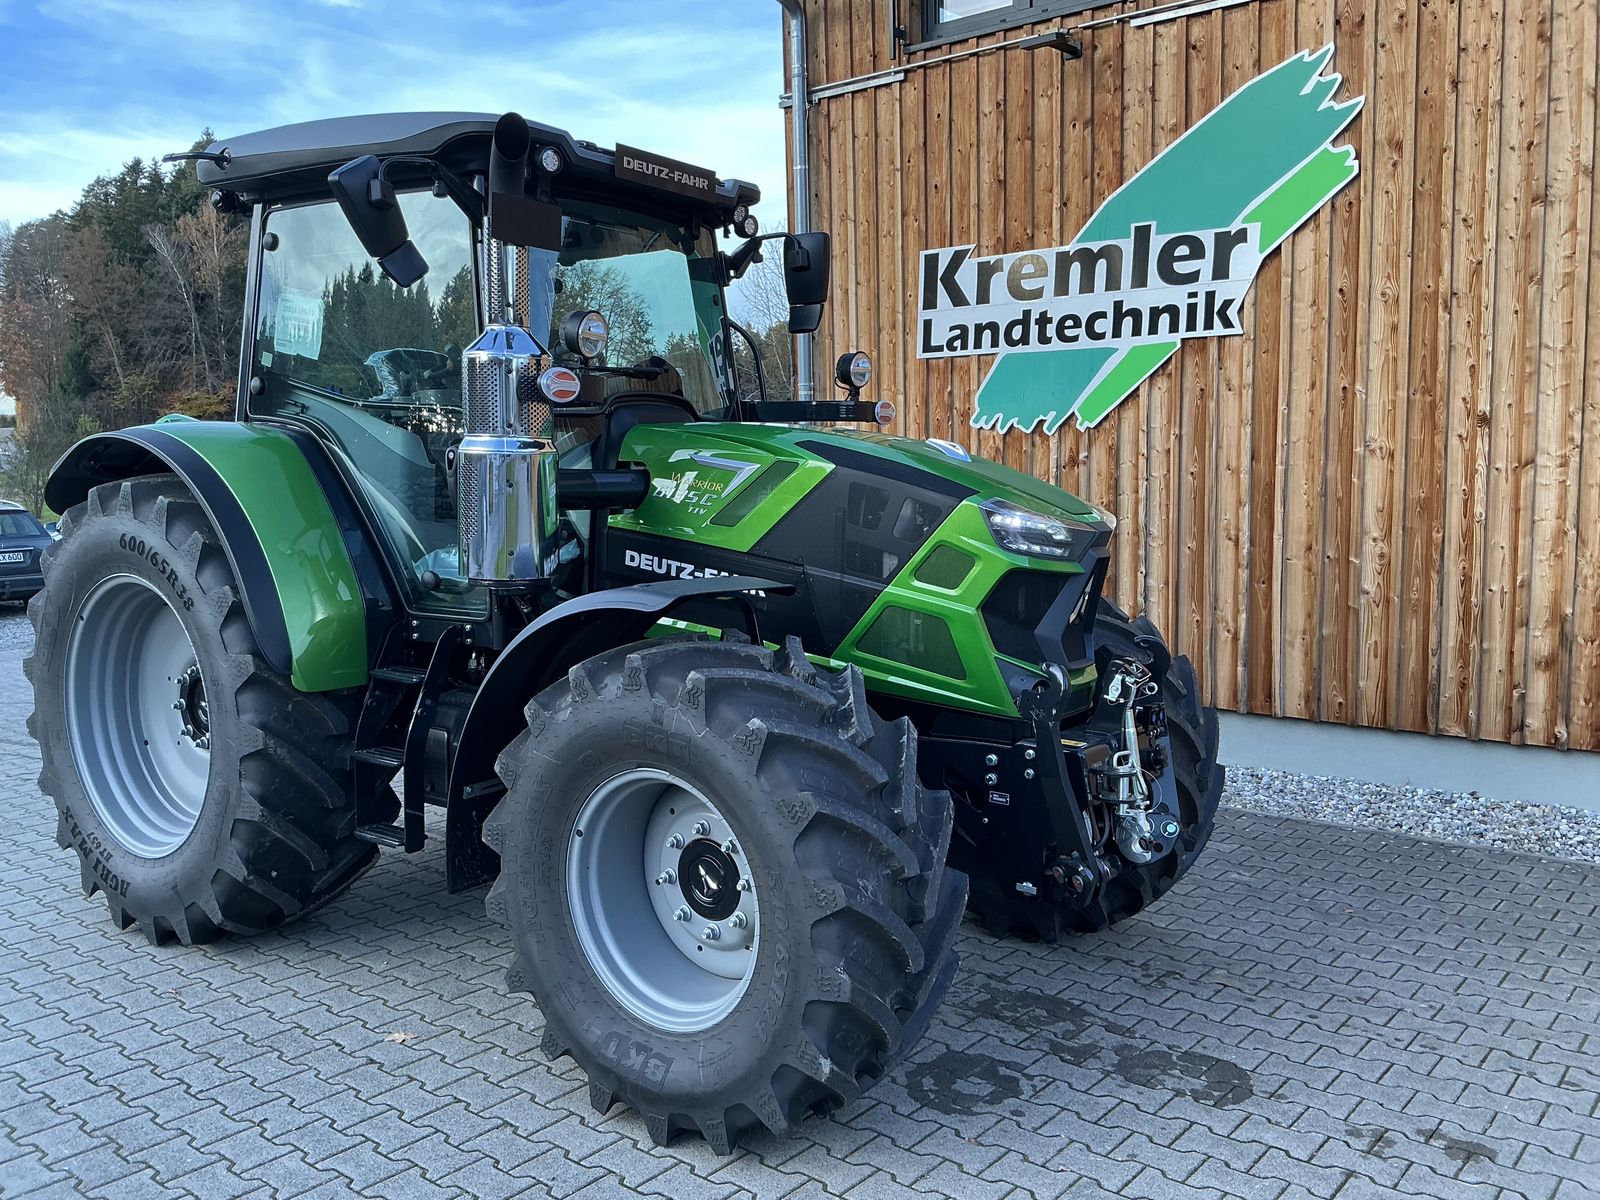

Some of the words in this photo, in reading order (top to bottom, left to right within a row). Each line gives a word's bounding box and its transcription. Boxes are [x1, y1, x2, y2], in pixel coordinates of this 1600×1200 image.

[623, 156, 709, 190] DEUTZ-FAHR
[922, 223, 1248, 310] Kremler
[922, 290, 1236, 354] Landtechnik
[8, 553, 22, 561] 600
[119, 532, 195, 612] 600/65R38
[86, 831, 102, 850] 657
[99, 847, 114, 863] RT
